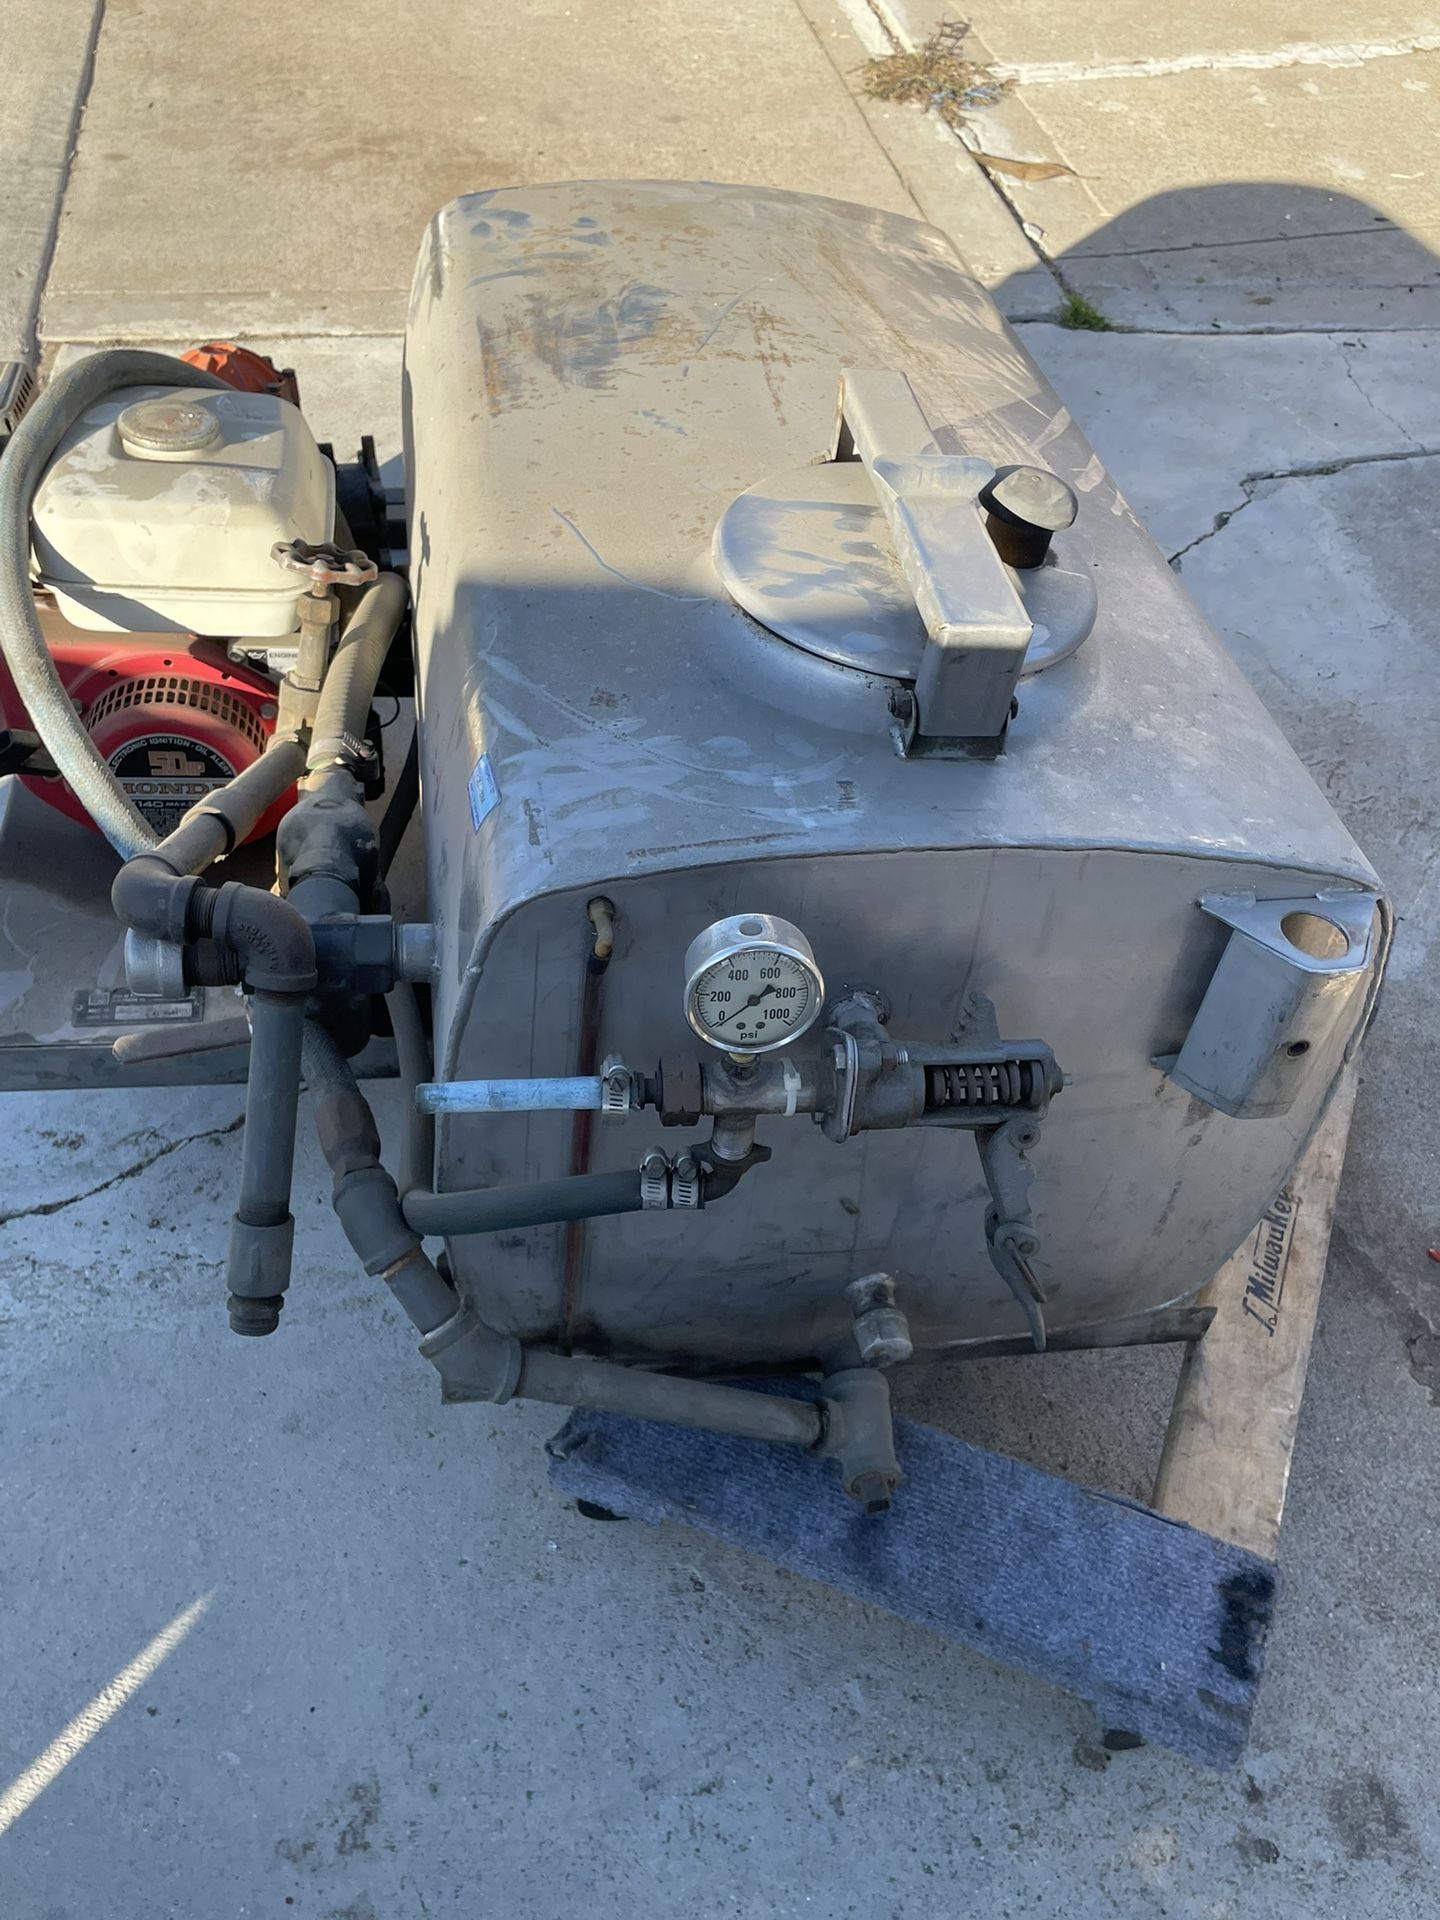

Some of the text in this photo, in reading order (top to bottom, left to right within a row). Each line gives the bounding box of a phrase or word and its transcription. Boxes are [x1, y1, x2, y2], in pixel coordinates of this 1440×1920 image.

[149, 737, 191, 748] IGNITION
[195, 744, 208, 756] OIL
[209, 753, 233, 776] ALERT
[728, 967, 781, 981] 400 600
[710, 987, 796, 1002] 200 800
[718, 1008, 790, 1021] 0 1000
[740, 1030, 758, 1040] psi
